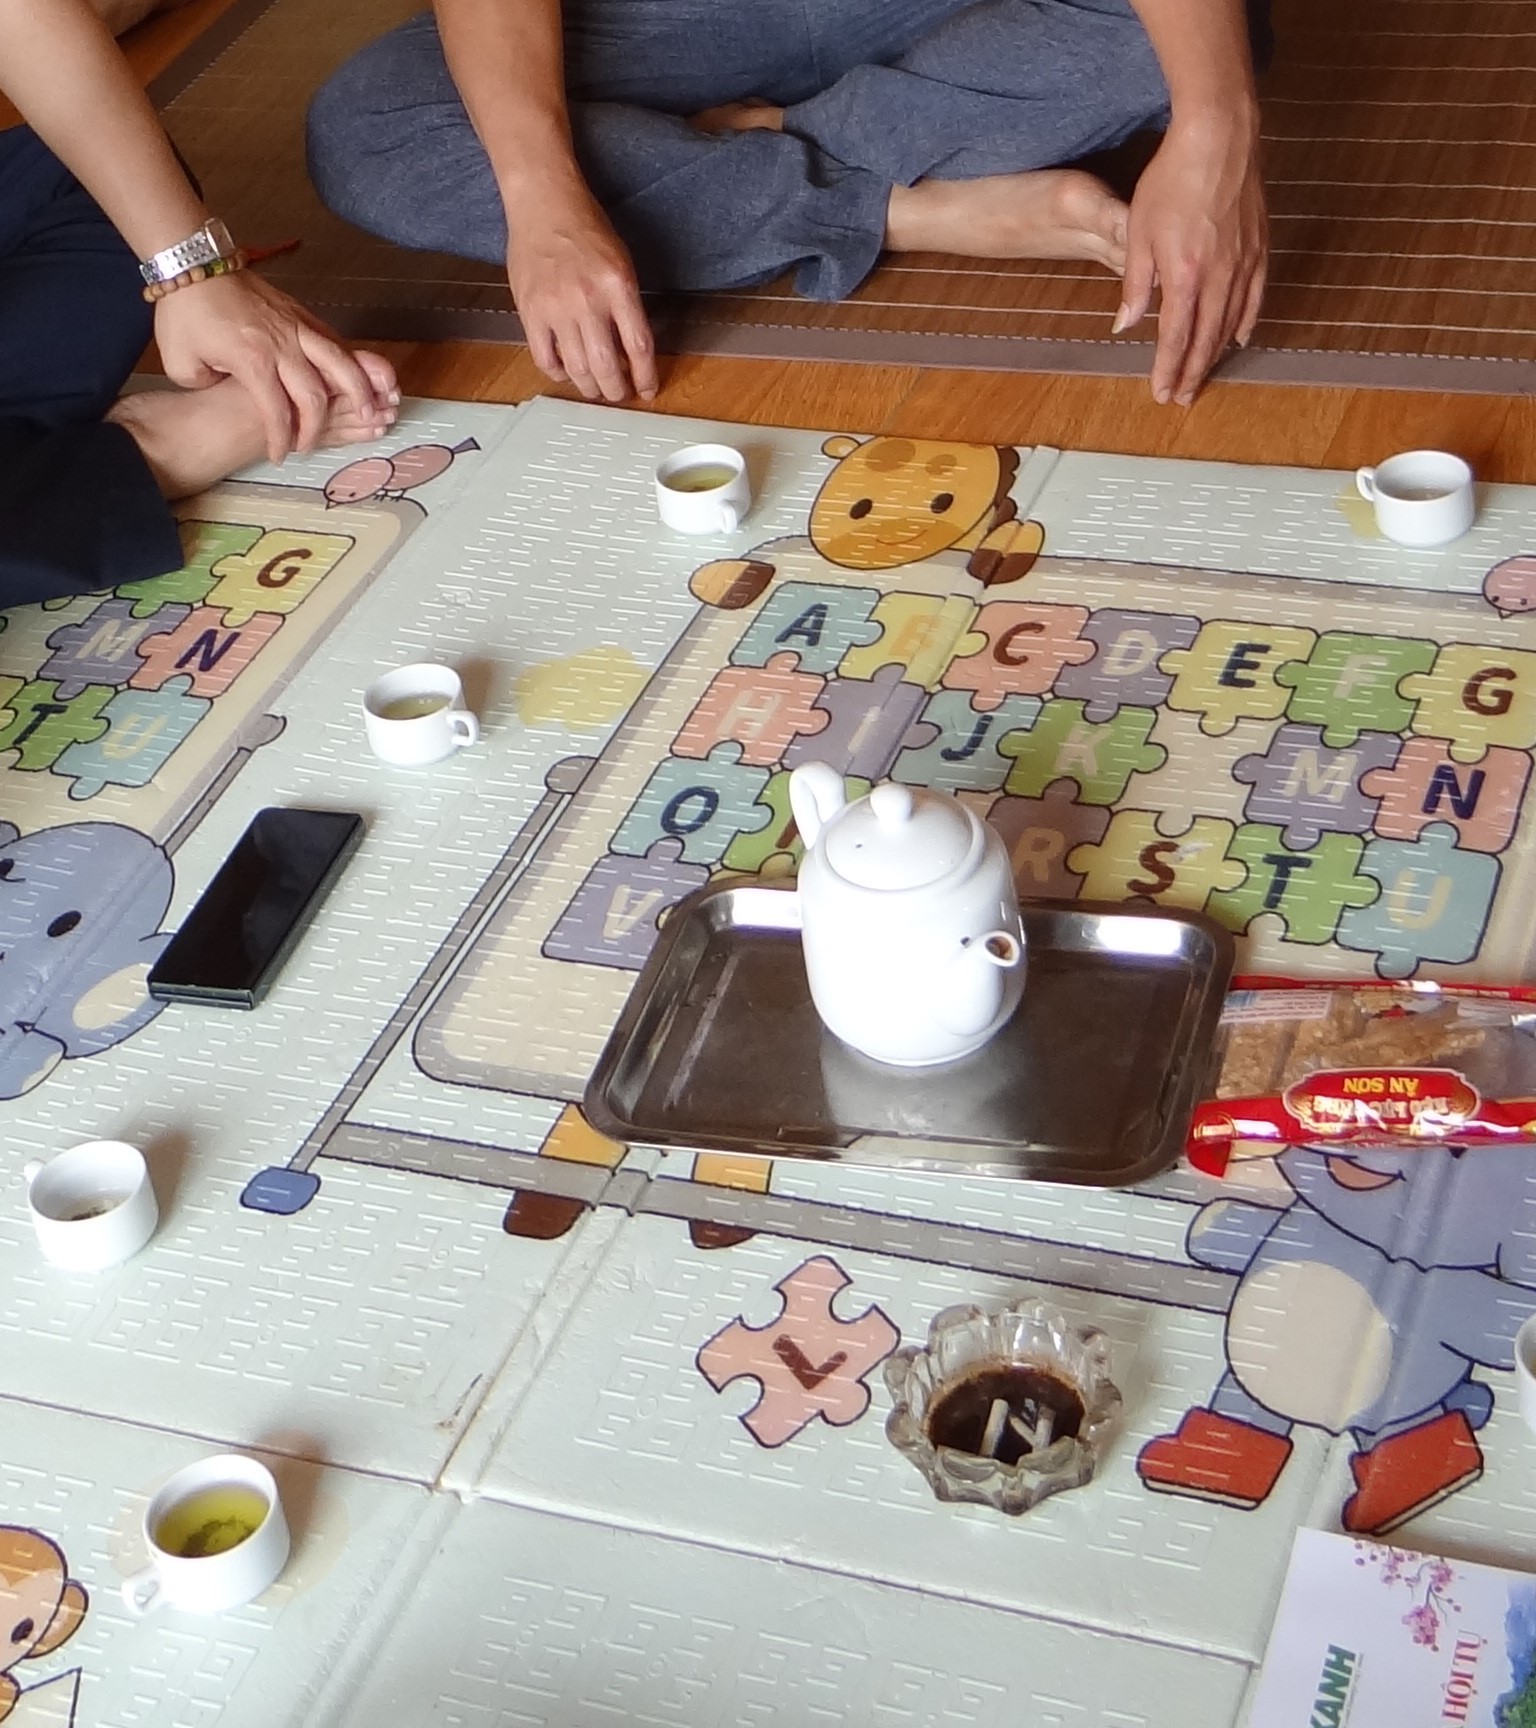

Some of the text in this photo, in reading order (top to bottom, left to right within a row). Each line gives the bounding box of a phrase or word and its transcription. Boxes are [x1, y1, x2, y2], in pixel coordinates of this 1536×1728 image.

[256, 548, 312, 589] G
[75, 619, 242, 672] M N
[774, 603, 829, 647] A
[993, 621, 1046, 666] C
[1102, 629, 1157, 676] D
[1217, 642, 1272, 688] E
[1333, 654, 1388, 699] F
[1461, 666, 1517, 716] G
[13, 702, 68, 745] T
[101, 712, 169, 760] U
[716, 690, 783, 738] H
[940, 714, 994, 761] J
[1054, 723, 1112, 775] K
[1280, 749, 1358, 803] M
[1421, 764, 1486, 820] N
[660, 786, 719, 835] O
[1126, 841, 1181, 895] S
[1263, 854, 1312, 908] T
[1385, 868, 1452, 930] U
[602, 884, 663, 939] V
[772, 1334, 848, 1390] L
[1440, 1629, 1489, 1721] HỘI TỤ
